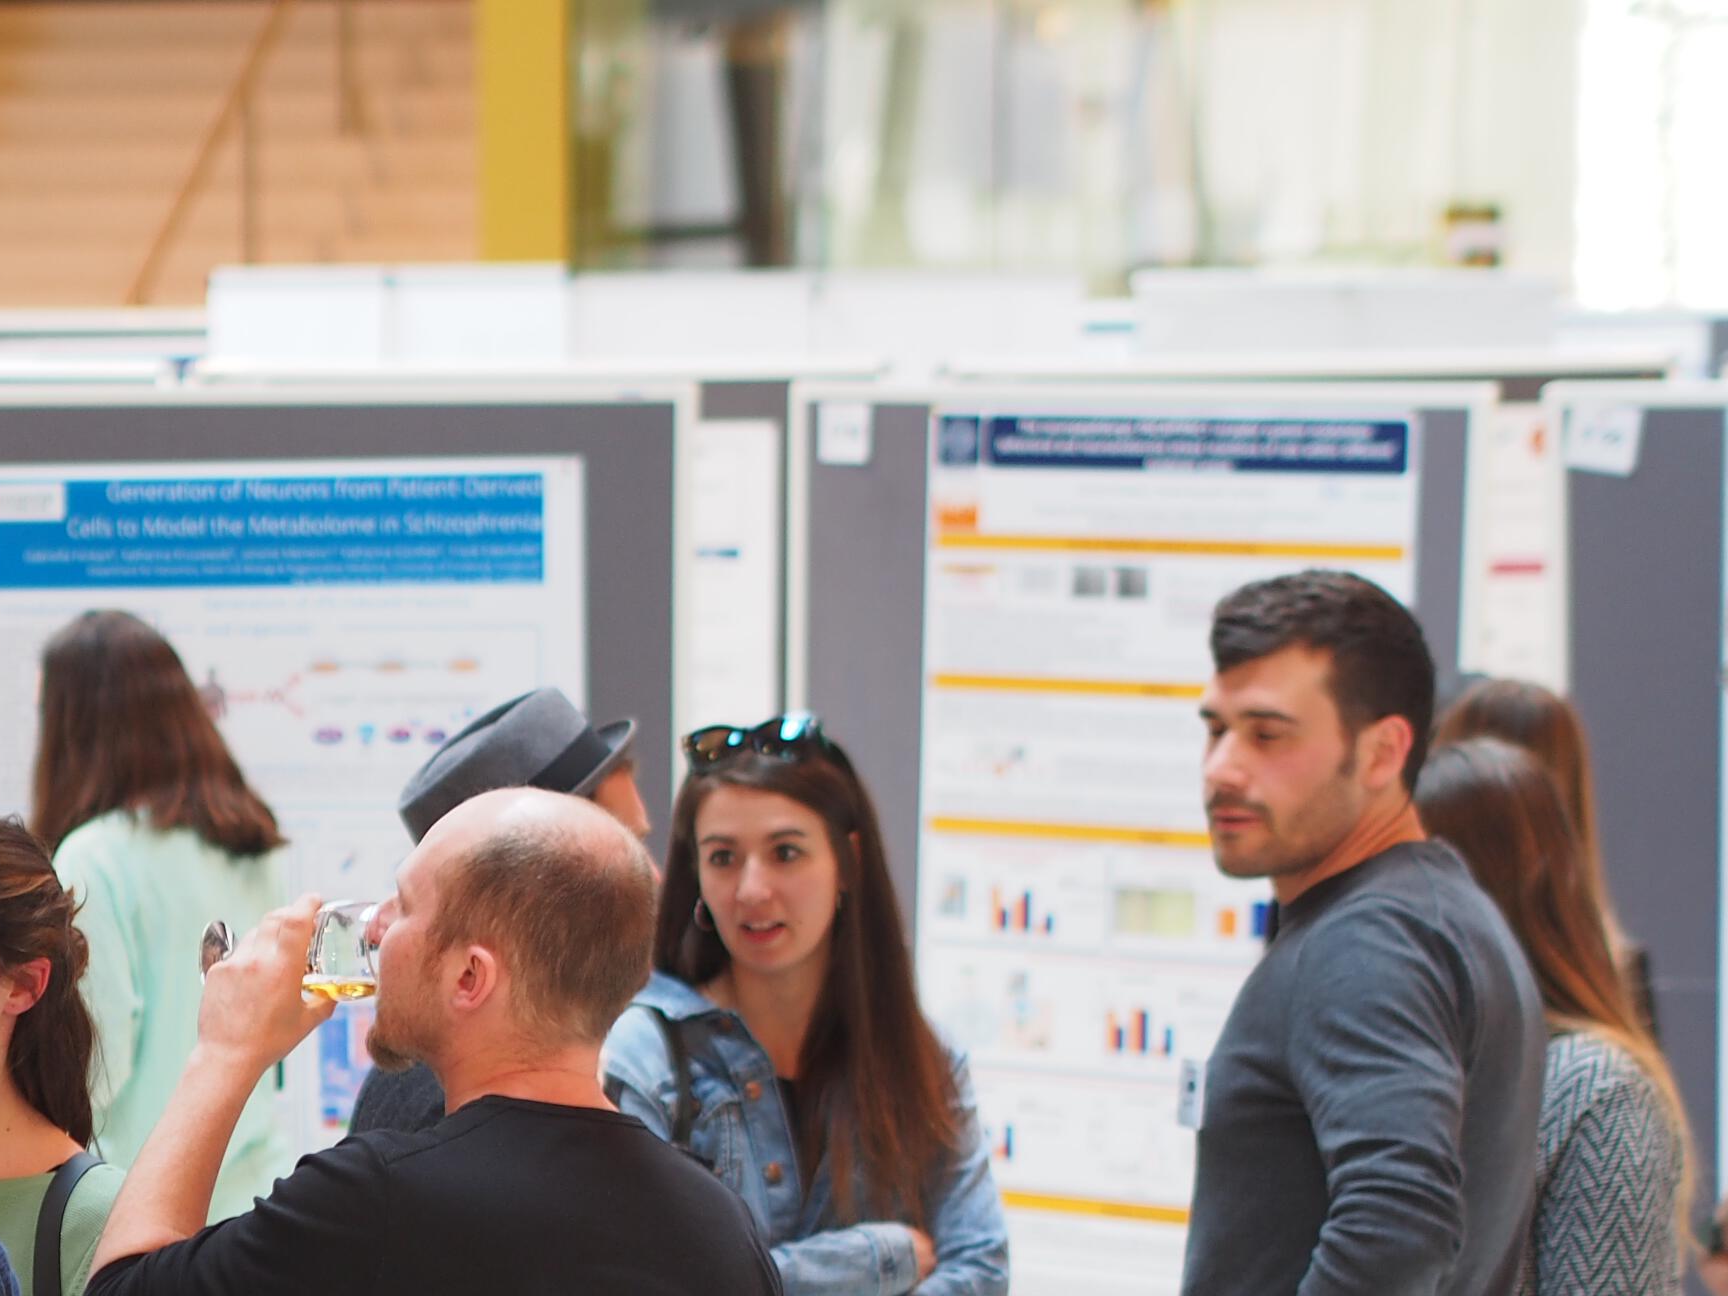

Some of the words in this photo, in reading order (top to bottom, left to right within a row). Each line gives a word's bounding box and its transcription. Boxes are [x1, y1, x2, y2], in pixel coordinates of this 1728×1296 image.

[66, 516, 111, 537] Cells
[117, 516, 139, 536] to
[144, 515, 204, 536] Model
[210, 514, 244, 535] the
[248, 512, 376, 534] Metabolome
[379, 512, 400, 532] in
[403, 510, 540, 538] Schizophrenia
